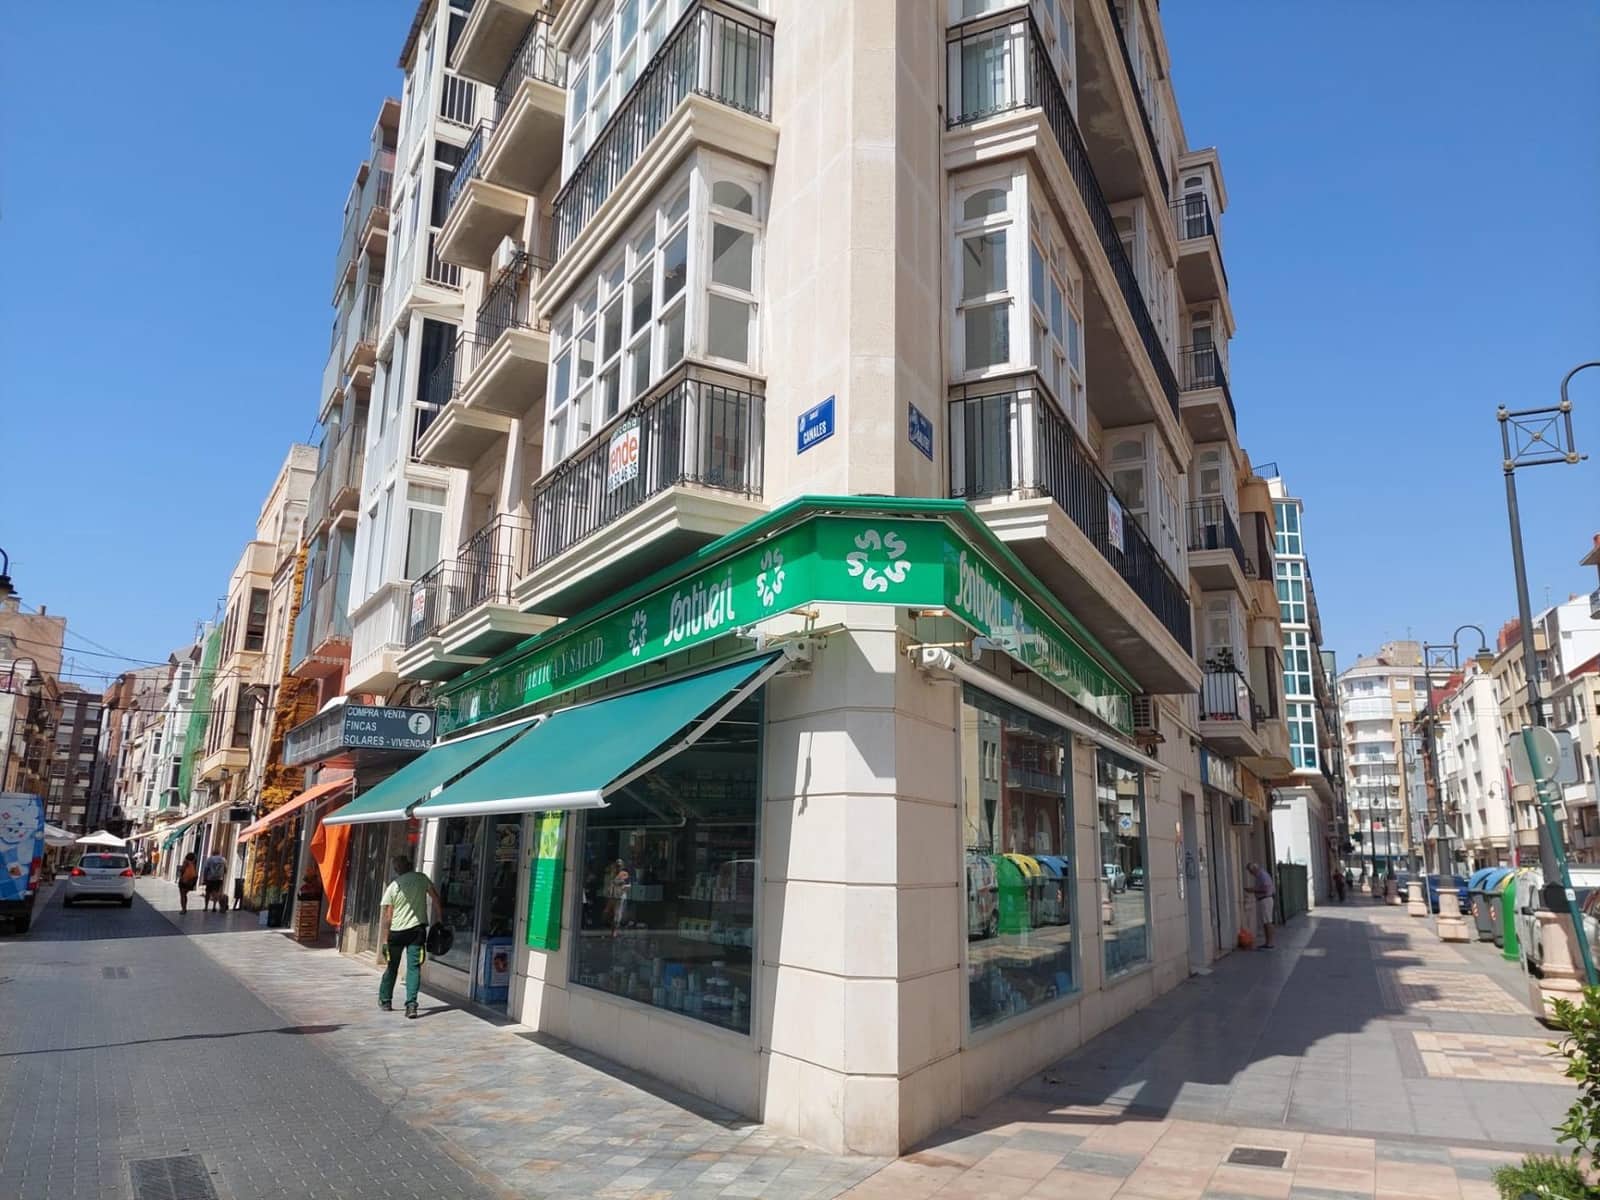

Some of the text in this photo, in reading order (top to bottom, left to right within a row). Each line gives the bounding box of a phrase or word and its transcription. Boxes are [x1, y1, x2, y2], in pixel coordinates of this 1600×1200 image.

[803, 420, 827, 445] CANALES
[663, 567, 736, 647] Santiveri
[569, 637, 604, 673] SALUD
[347, 706, 406, 720] COMPRA VENTA
[346, 720, 377, 731] FINCAS
[344, 734, 385, 746] SOLARES
[391, 737, 432, 749] VIVIENDAS
